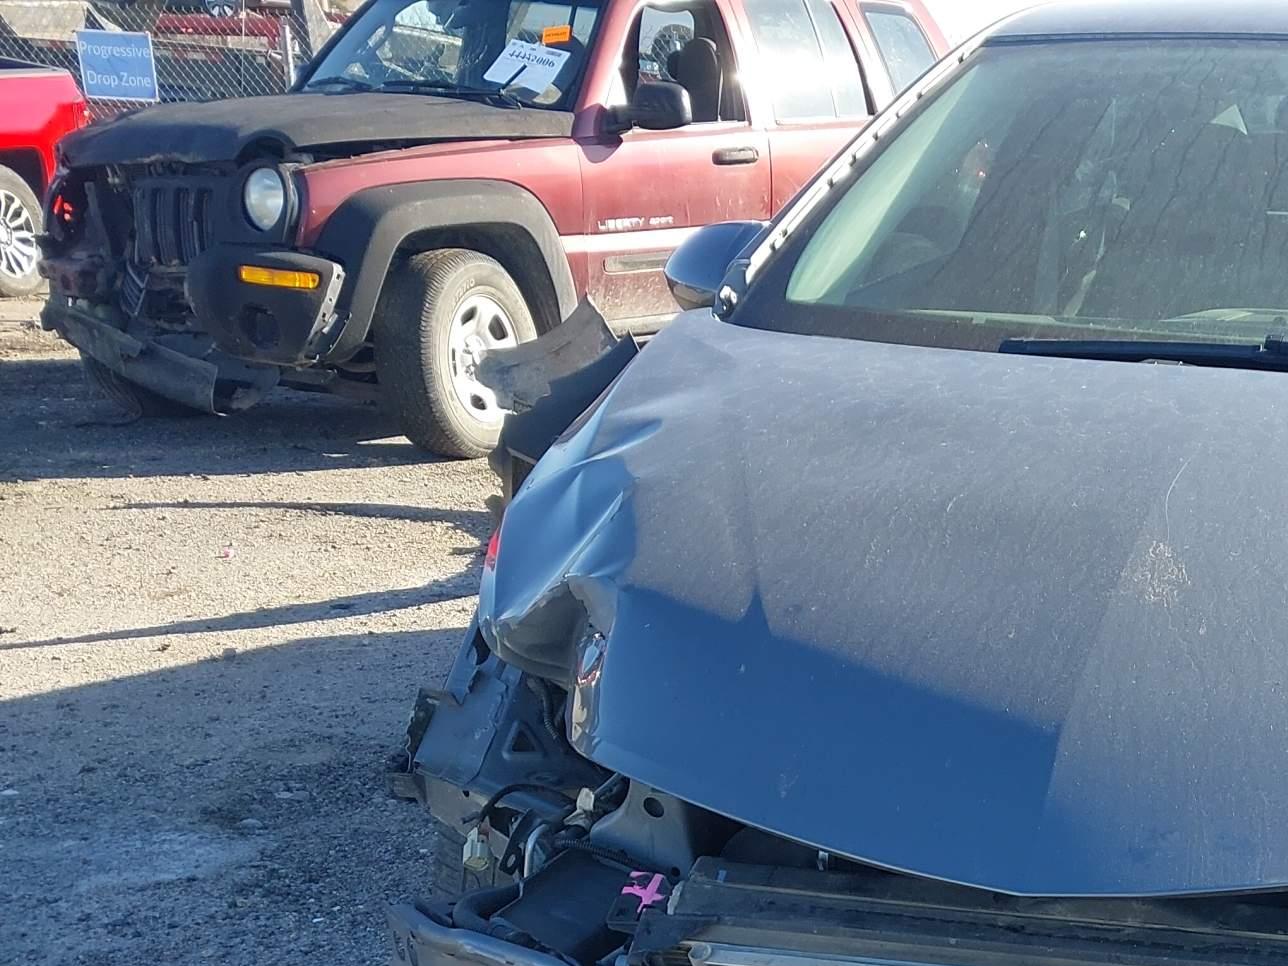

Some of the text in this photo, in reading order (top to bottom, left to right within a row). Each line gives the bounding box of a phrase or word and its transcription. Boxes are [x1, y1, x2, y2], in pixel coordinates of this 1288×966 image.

[80, 41, 150, 58] Progressive
[87, 70, 152, 88] Drop Zone
